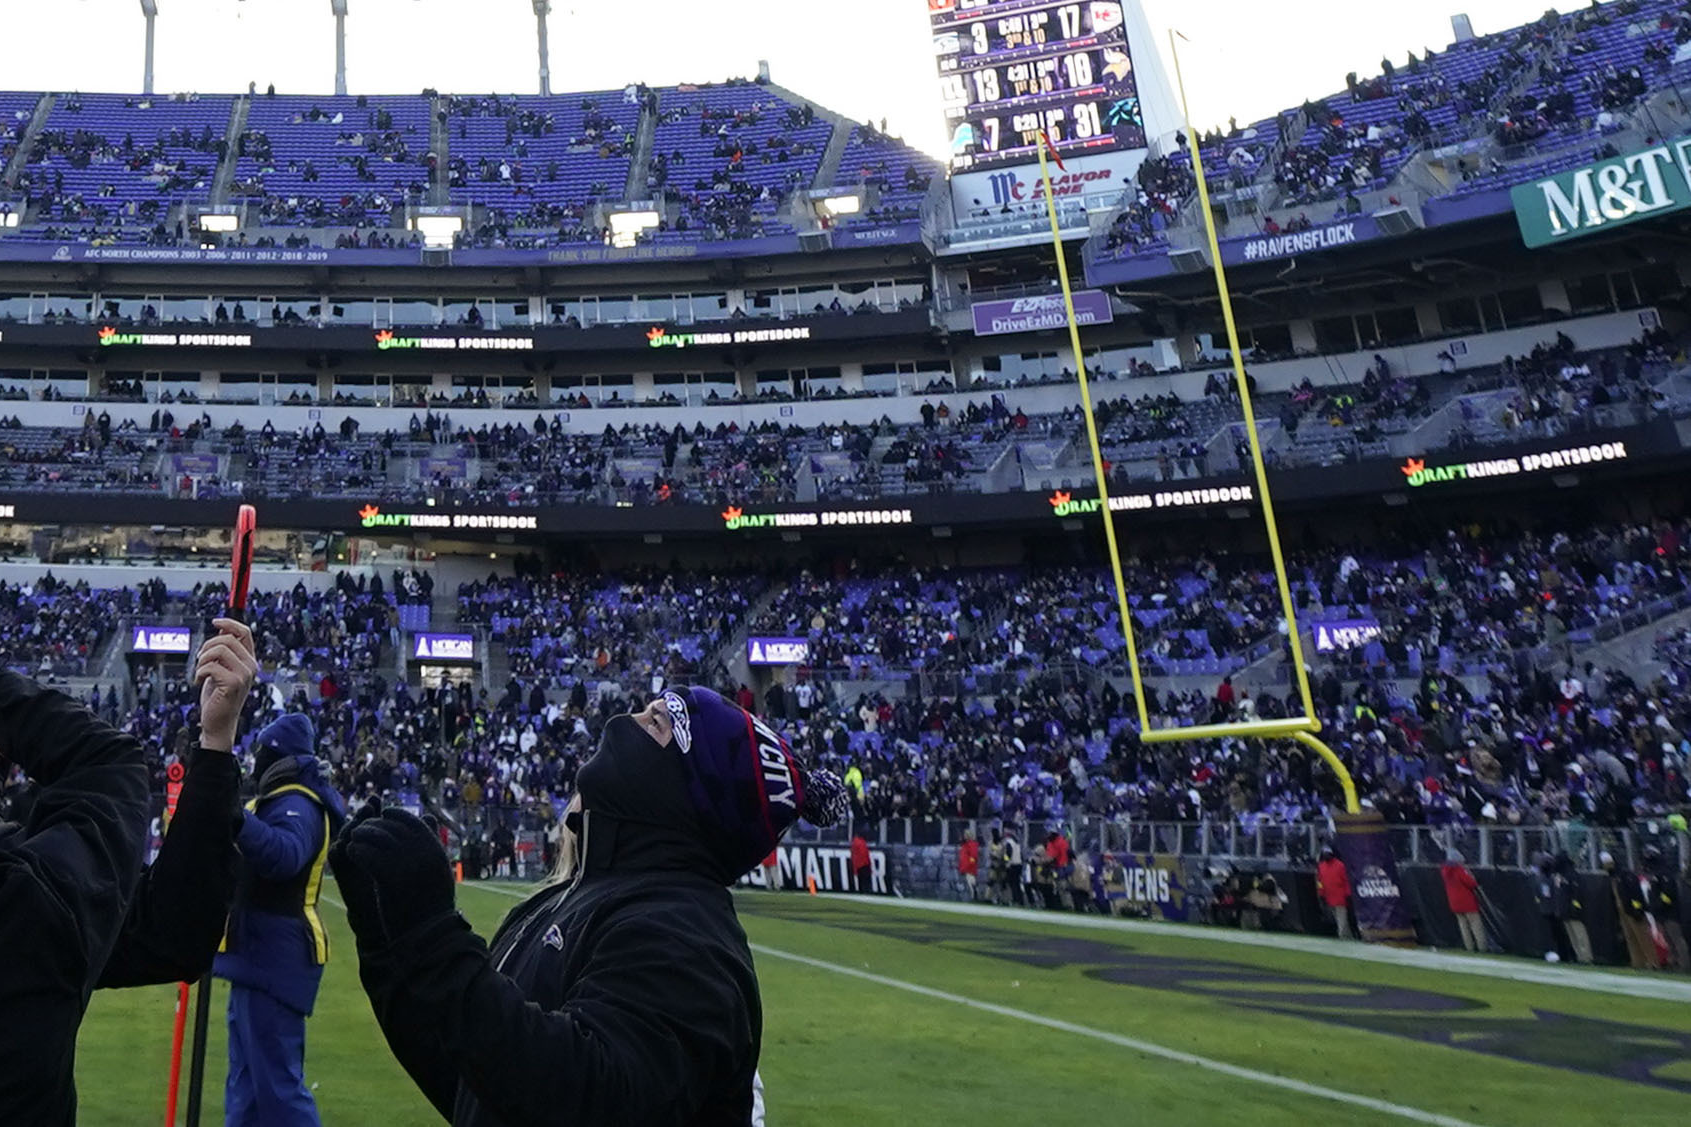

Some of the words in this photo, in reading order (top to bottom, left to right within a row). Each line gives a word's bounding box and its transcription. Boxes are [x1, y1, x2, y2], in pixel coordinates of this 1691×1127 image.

[971, 23, 989, 55] 3
[1058, 4, 1079, 39] 17
[1034, 28, 1046, 44] 10
[973, 68, 1000, 102] 13
[1040, 76, 1053, 92] 10
[1073, 102, 1101, 138] 31
[1537, 147, 1675, 236] M&T
[1244, 223, 1356, 260] #RAVENSFLOCK
[84, 249, 100, 259] AFC
[101, 249, 129, 259] NORTH
[131, 249, 179, 260] CHAMPIONS
[256, 250, 277, 261] 2012
[306, 251, 328, 261] 2019
[548, 250, 579, 262] THANK
[581, 250, 600, 261] YOU
[991, 311, 1096, 332] DriveEzMD.om
[100, 331, 178, 347] DRAFTKINGS
[179, 333, 252, 347] SPORTSBOOK
[378, 337, 457, 350] DRAFTKINGS
[458, 337, 534, 350] SPORTSBOOK
[649, 331, 732, 348] DRAFTKINGS
[734, 327, 810, 343] SPORTSBOOK
[1407, 458, 1520, 487] DRAFTKINGS
[1521, 441, 1628, 472] SPORTSBOOK
[1155, 485, 1253, 507] SPORTSBOOK
[362, 512, 451, 528] DRAFTKINGS
[453, 514, 537, 529] SPORTSBOOK
[724, 512, 818, 530] DRAFTKINGS
[820, 509, 912, 527] SPORTSBOOK
[759, 743, 797, 809] CITY
[776, 846, 888, 894] MATTR
[1122, 867, 1170, 903] VENS
